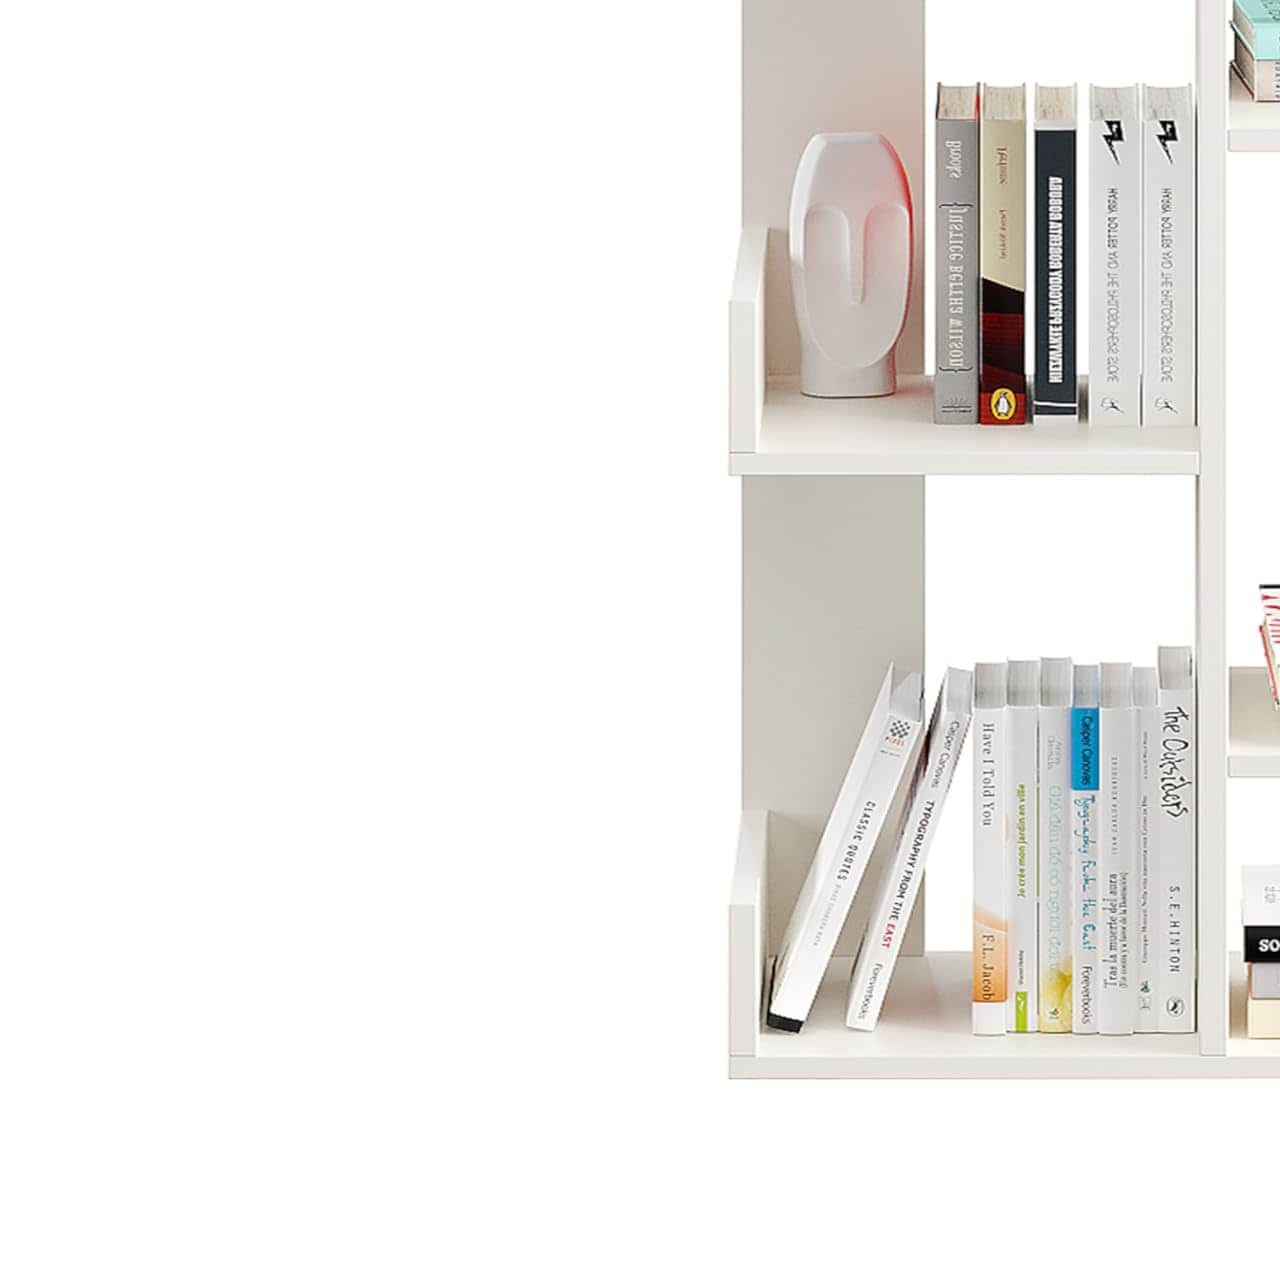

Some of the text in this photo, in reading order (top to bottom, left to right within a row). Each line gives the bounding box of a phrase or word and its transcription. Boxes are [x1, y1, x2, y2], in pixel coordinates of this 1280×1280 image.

[943, 720, 960, 753] Casper
[982, 723, 995, 757] Have
[1080, 715, 1094, 786] Casper Canovas
[982, 768, 995, 797] Told
[1158, 705, 1192, 818] The Outsiders
[982, 800, 995, 826] You
[837, 800, 876, 881] CLASSIC QUOTES
[1017, 845, 1025, 867] mon
[881, 800, 935, 949] TYPOGRAPHY FROM THE EAST
[1101, 873, 1118, 989] Tras la muerte del aura
[982, 963, 995, 1001] Jacob
[1080, 965, 1093, 1026] Foreverbooks
